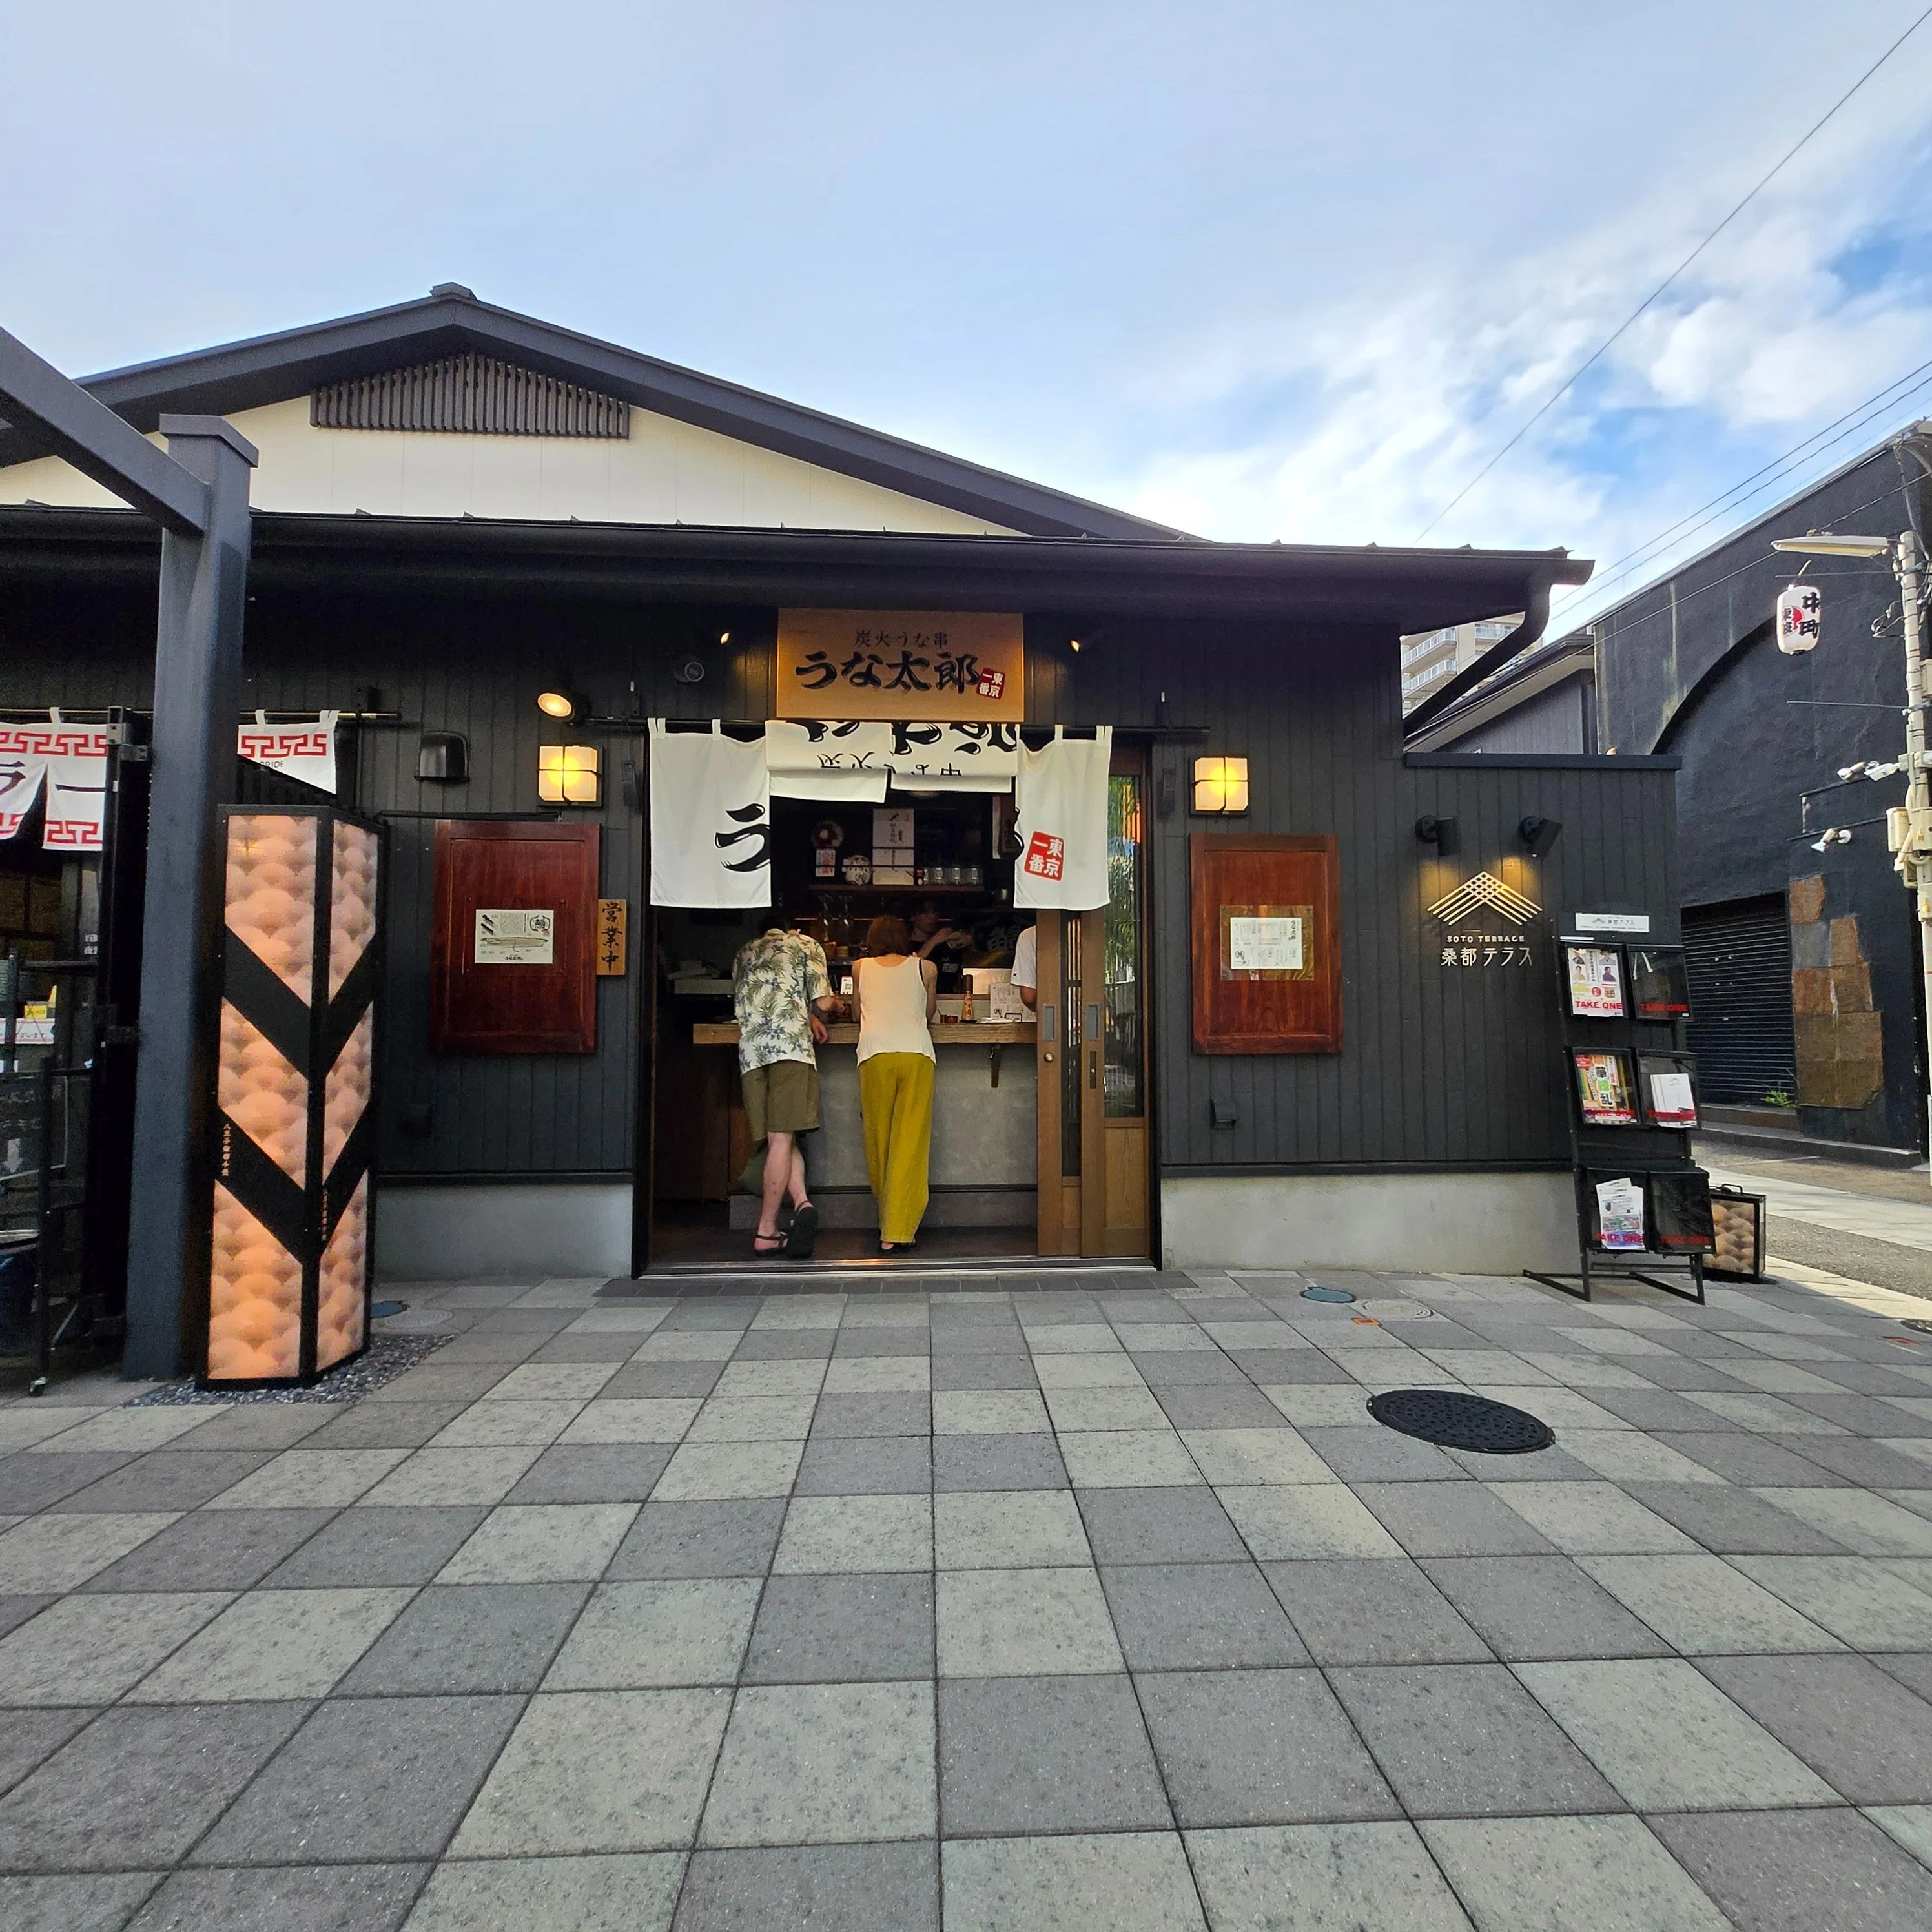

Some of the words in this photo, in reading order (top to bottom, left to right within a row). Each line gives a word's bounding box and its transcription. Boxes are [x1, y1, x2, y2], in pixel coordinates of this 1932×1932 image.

[855, 630, 949, 649] 炭火うな串
[796, 650, 980, 694] うな太郎
[1043, 838, 1063, 878] 東京
[601, 901, 623, 973] 営業中
[1441, 947, 1532, 967] 桑都テラス
